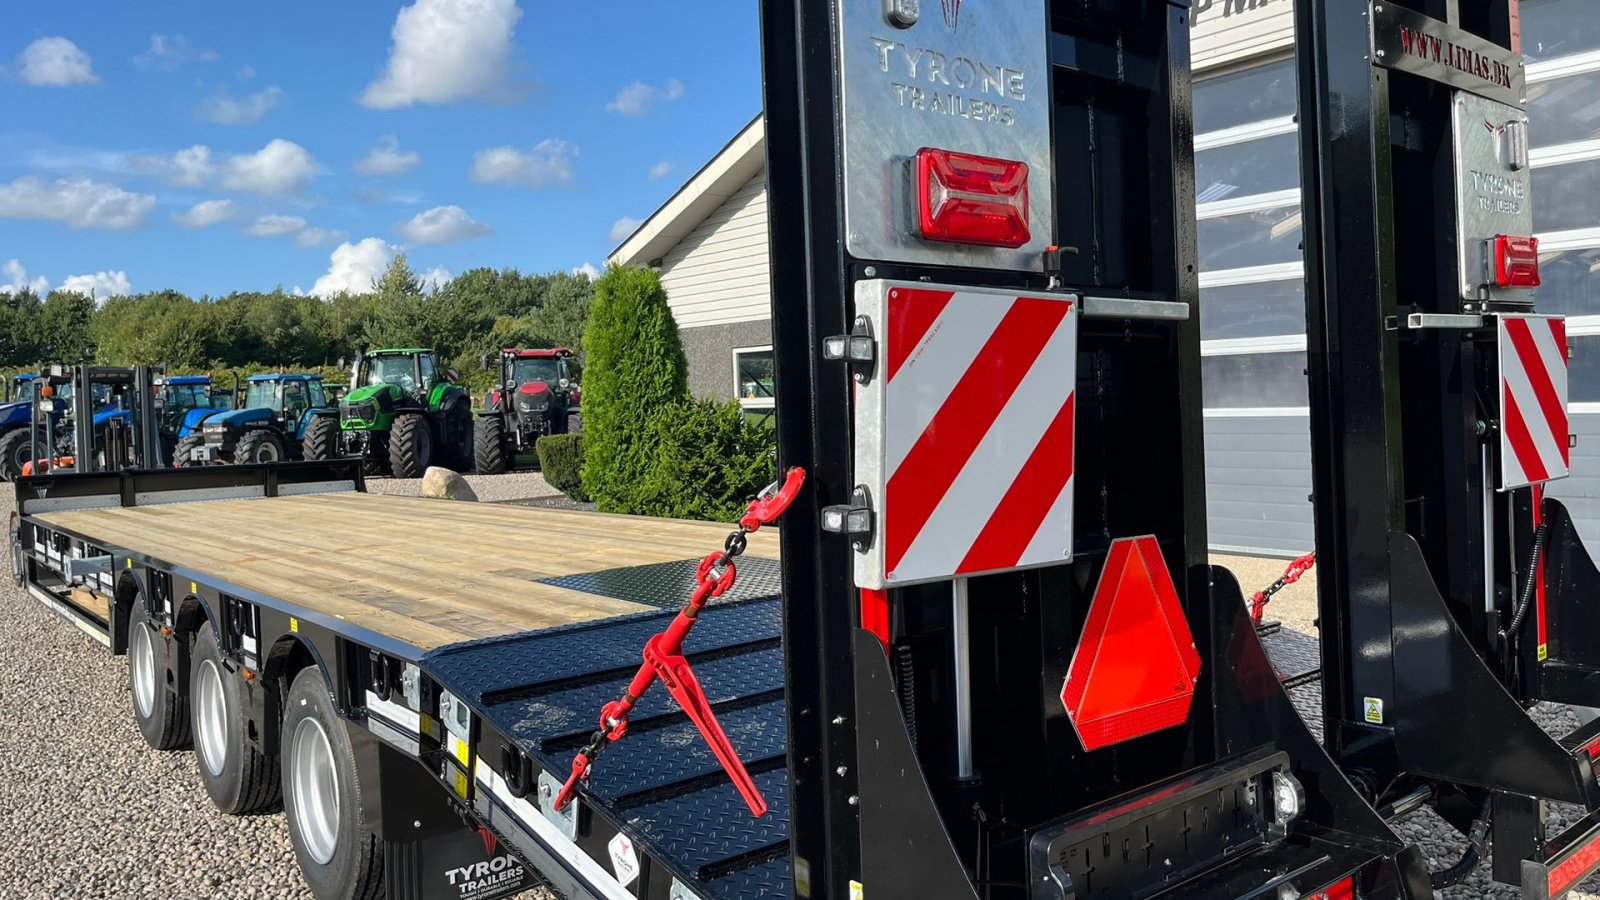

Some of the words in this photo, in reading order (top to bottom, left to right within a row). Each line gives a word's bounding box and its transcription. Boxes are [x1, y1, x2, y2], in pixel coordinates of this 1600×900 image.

[870, 37, 1025, 101] TYRONE
[891, 83, 1015, 126] TRAILERS
[1470, 169, 1524, 199] TYRONE
[445, 853, 520, 885] TYRON
[459, 866, 524, 893] TRAILERS
